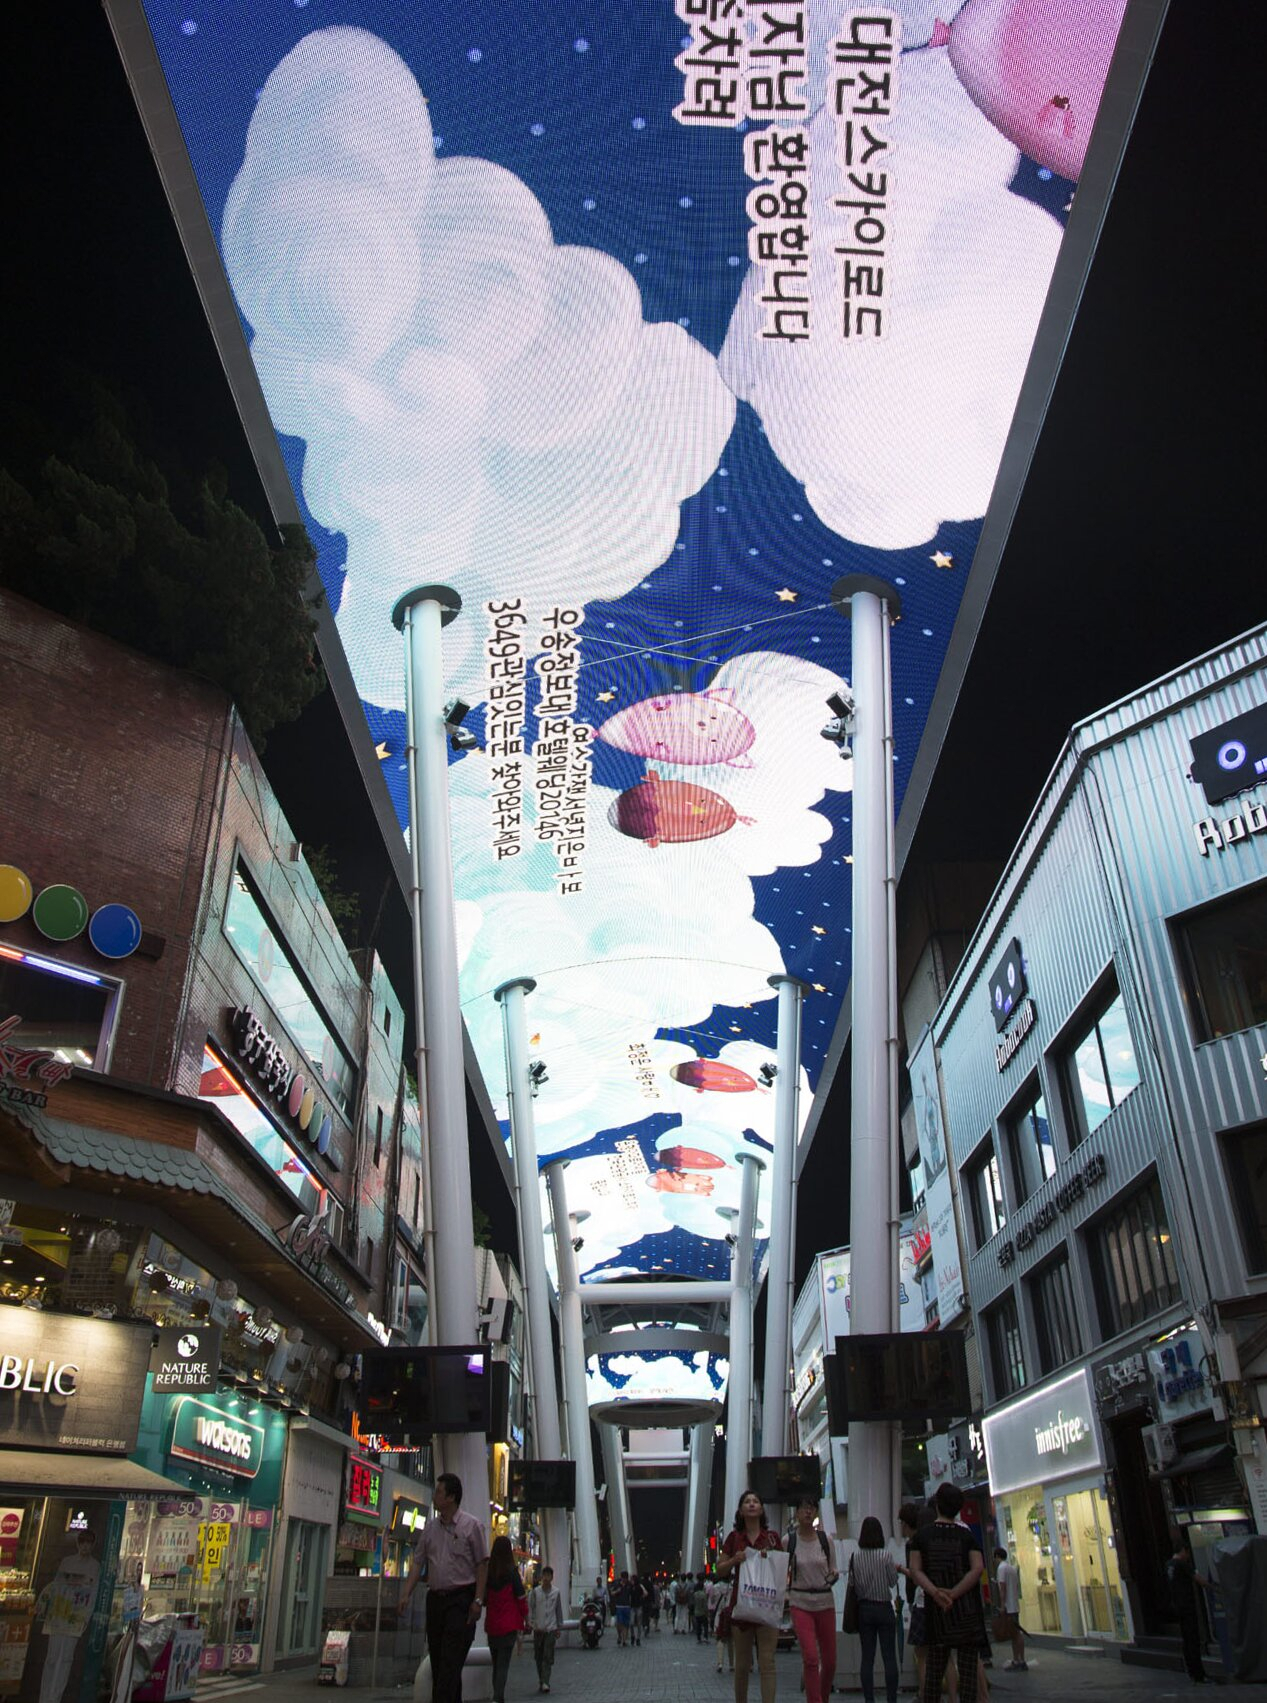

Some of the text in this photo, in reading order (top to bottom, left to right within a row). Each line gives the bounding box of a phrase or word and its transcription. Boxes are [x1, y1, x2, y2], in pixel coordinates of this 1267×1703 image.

[749, 0, 809, 342] 자님 환영합니다
[835, 17, 893, 338] 대전스카이로드
[540, 607, 579, 715] 우송정보대
[488, 598, 527, 861] 3649관심잇는분 찾아와주세요
[9, 1086, 47, 1109] BAR
[156, 1373, 211, 1385] REPUBLIC
[161, 1362, 208, 1374] NATURE
[1034, 1410, 1085, 1455] innisfree
[743, 1584, 777, 1597] TOMATO
